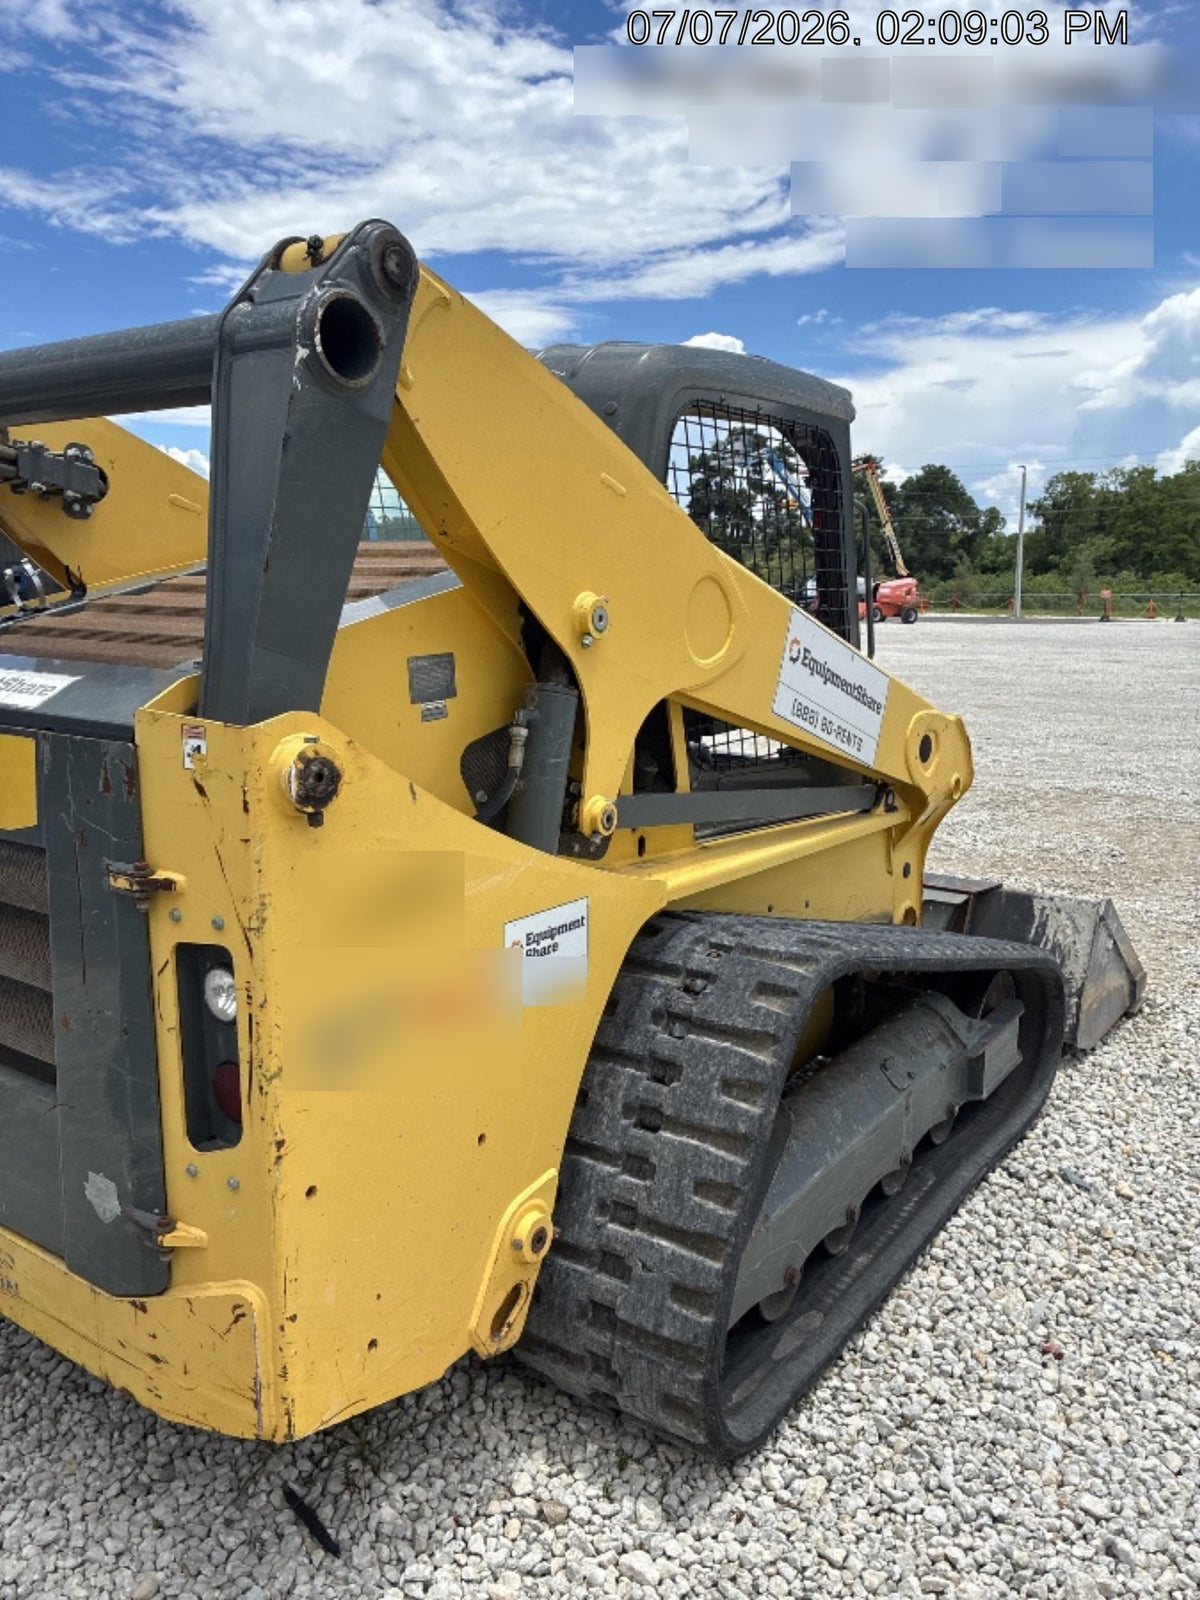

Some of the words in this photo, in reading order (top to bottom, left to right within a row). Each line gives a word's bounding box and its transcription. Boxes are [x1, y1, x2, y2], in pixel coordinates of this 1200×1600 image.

[0, 676, 57, 696] Share
[801, 647, 882, 715] EquipmentShare
[526, 915, 585, 946] Equipment
